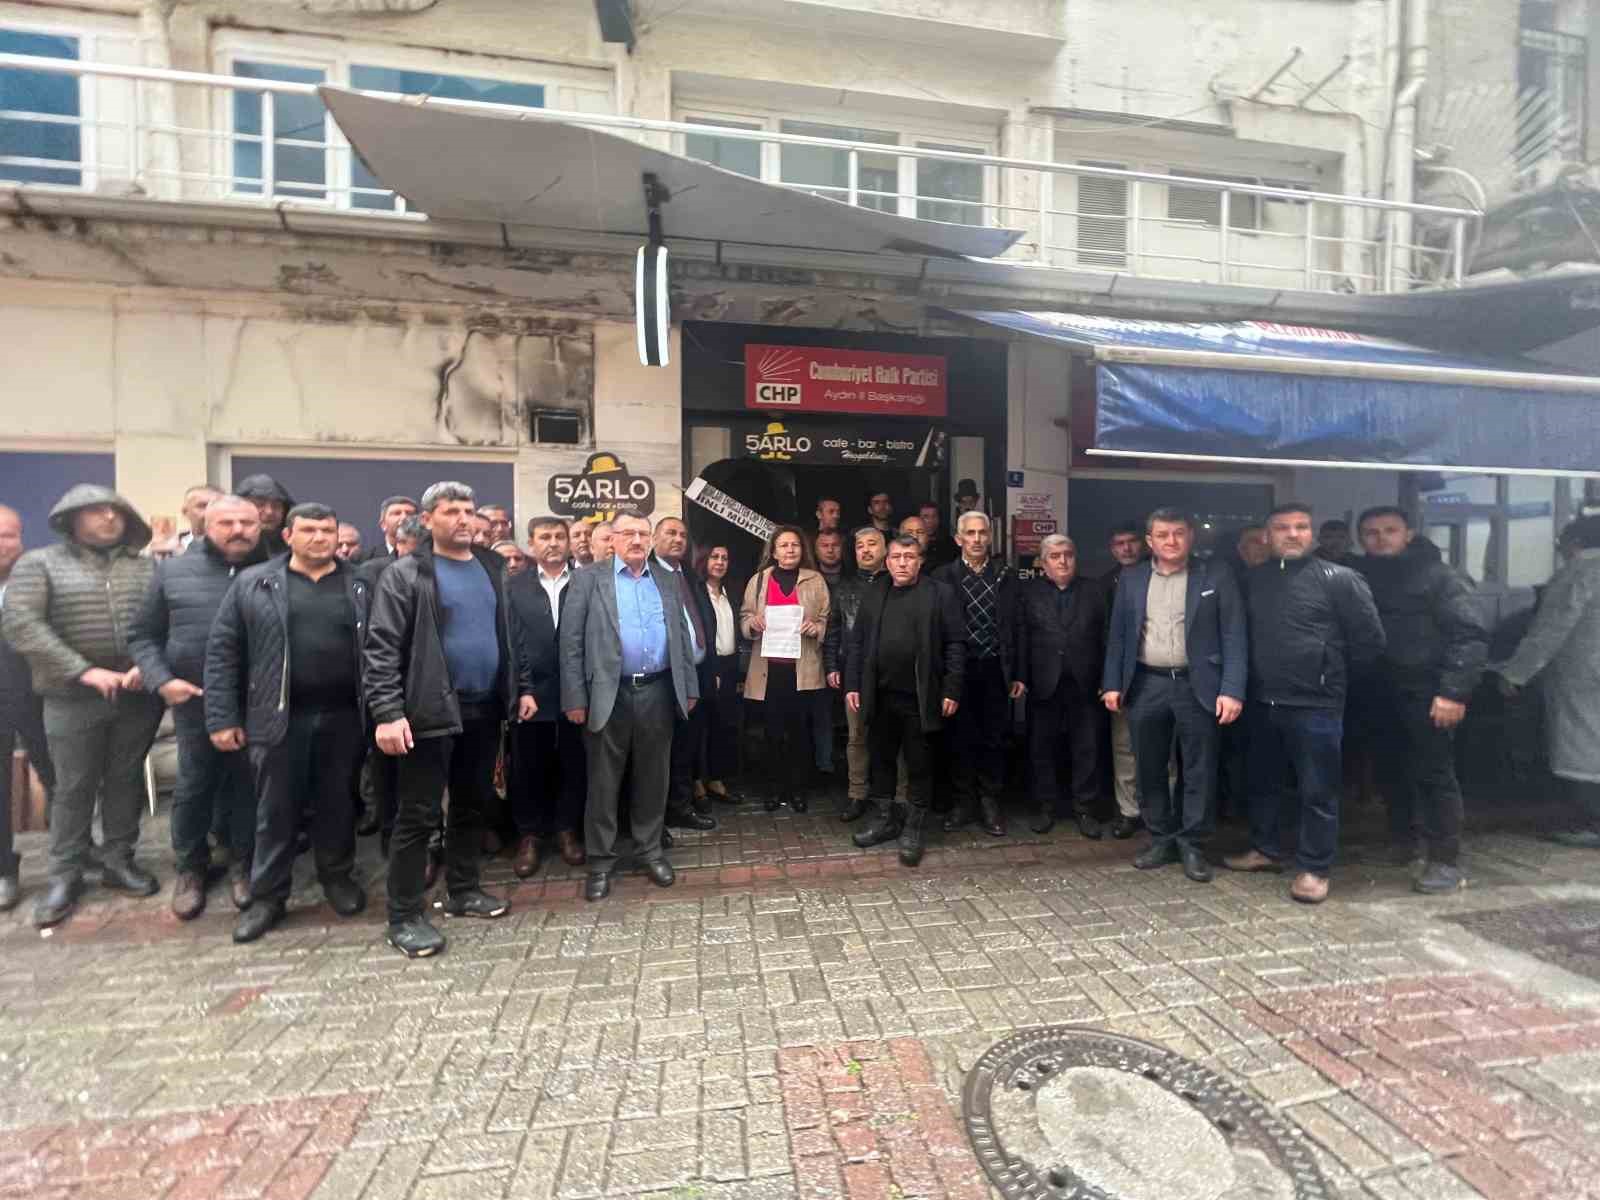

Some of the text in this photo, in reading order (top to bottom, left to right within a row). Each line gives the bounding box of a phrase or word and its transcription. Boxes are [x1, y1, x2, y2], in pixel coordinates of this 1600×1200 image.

[809, 361, 939, 386] Cumhuriyet Halk Partisi
[759, 385, 798, 401] CHP
[823, 438, 914, 450] cafe bar bistro
[1034, 522, 1056, 532] CHP
